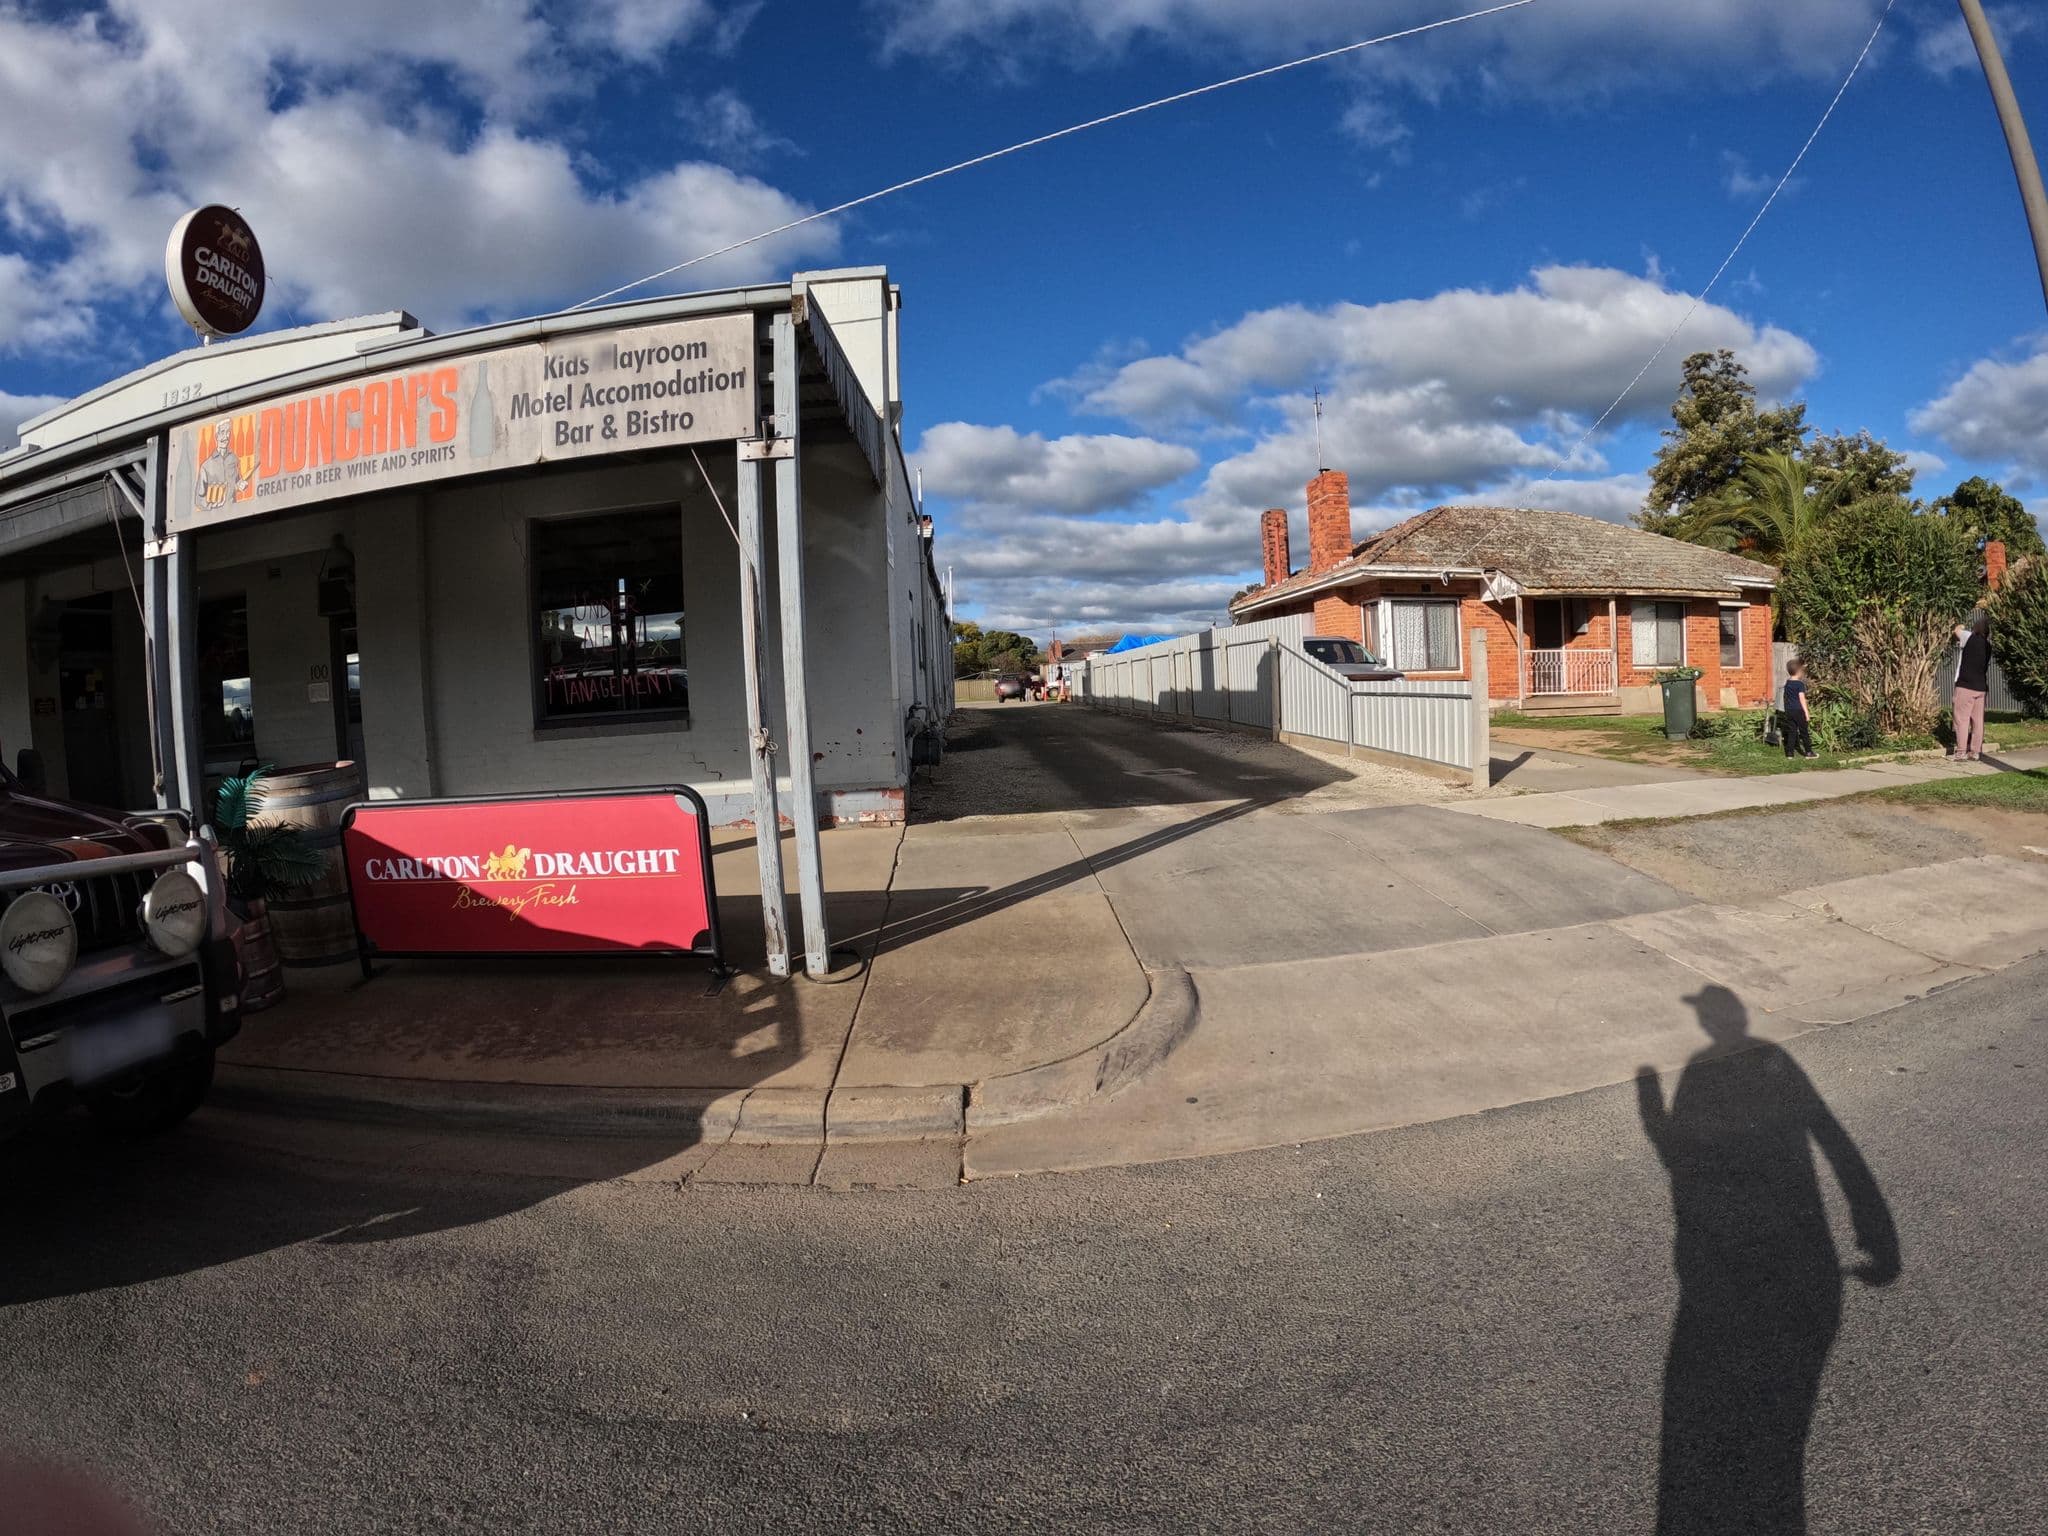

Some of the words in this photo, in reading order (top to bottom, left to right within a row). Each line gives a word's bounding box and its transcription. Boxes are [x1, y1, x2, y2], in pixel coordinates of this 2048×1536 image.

[194, 246, 258, 298] CARLTON
[196, 267, 252, 309] DRAUGHT
[543, 354, 589, 380] Kids
[596, 341, 707, 373] layroom
[161, 382, 202, 408] 1932
[510, 384, 573, 420] Motel
[579, 367, 746, 409] Accomodation
[259, 367, 458, 479] DUNCAN'S
[555, 420, 594, 446] Bar
[600, 413, 618, 440] &
[626, 410, 694, 437] Bistro
[256, 478, 289, 497] GREAT
[291, 474, 312, 489] FOR
[315, 467, 341, 485] BEER
[347, 460, 377, 478] WINE
[381, 453, 407, 470] AND
[410, 445, 456, 467] SPIRITS
[310, 664, 328, 680] 100
[549, 665, 673, 705] MANAGEMENT
[365, 855, 480, 881] CARLTON
[534, 848, 680, 877] DRAUGHT
[452, 886, 530, 920] Brewery
[525, 883, 579, 907] Fresh
